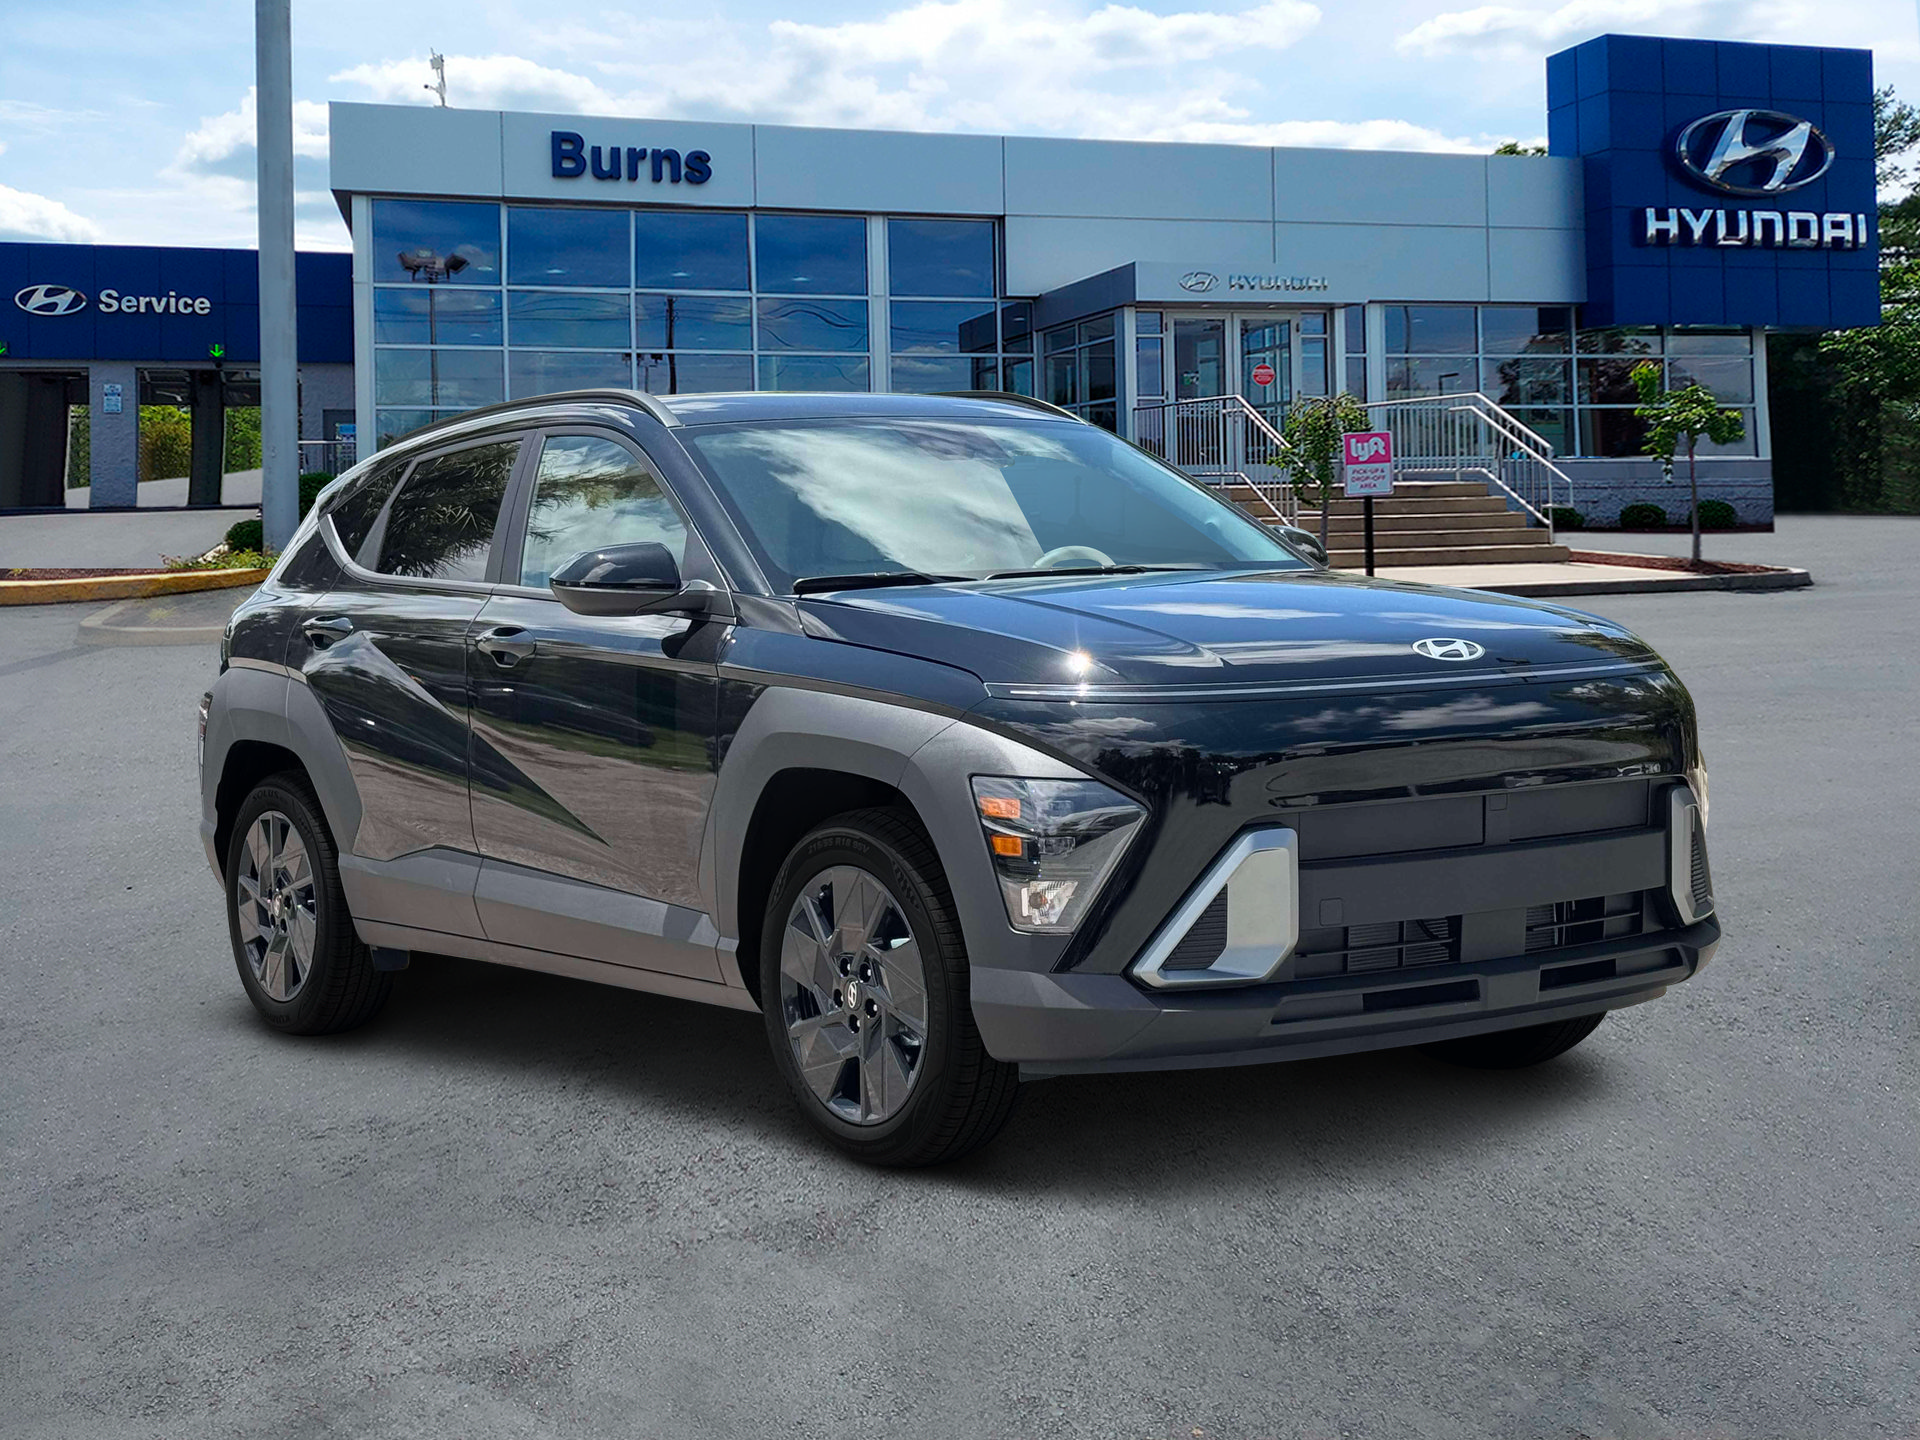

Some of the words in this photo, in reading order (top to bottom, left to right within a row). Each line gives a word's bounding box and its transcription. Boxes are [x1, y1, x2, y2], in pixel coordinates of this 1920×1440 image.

[551, 130, 712, 184] Burns
[1646, 207, 1868, 248] HYUNDAI
[1229, 274, 1328, 291] HYUNDAI
[99, 289, 211, 315] Service
[1350, 436, 1385, 461] lyft
